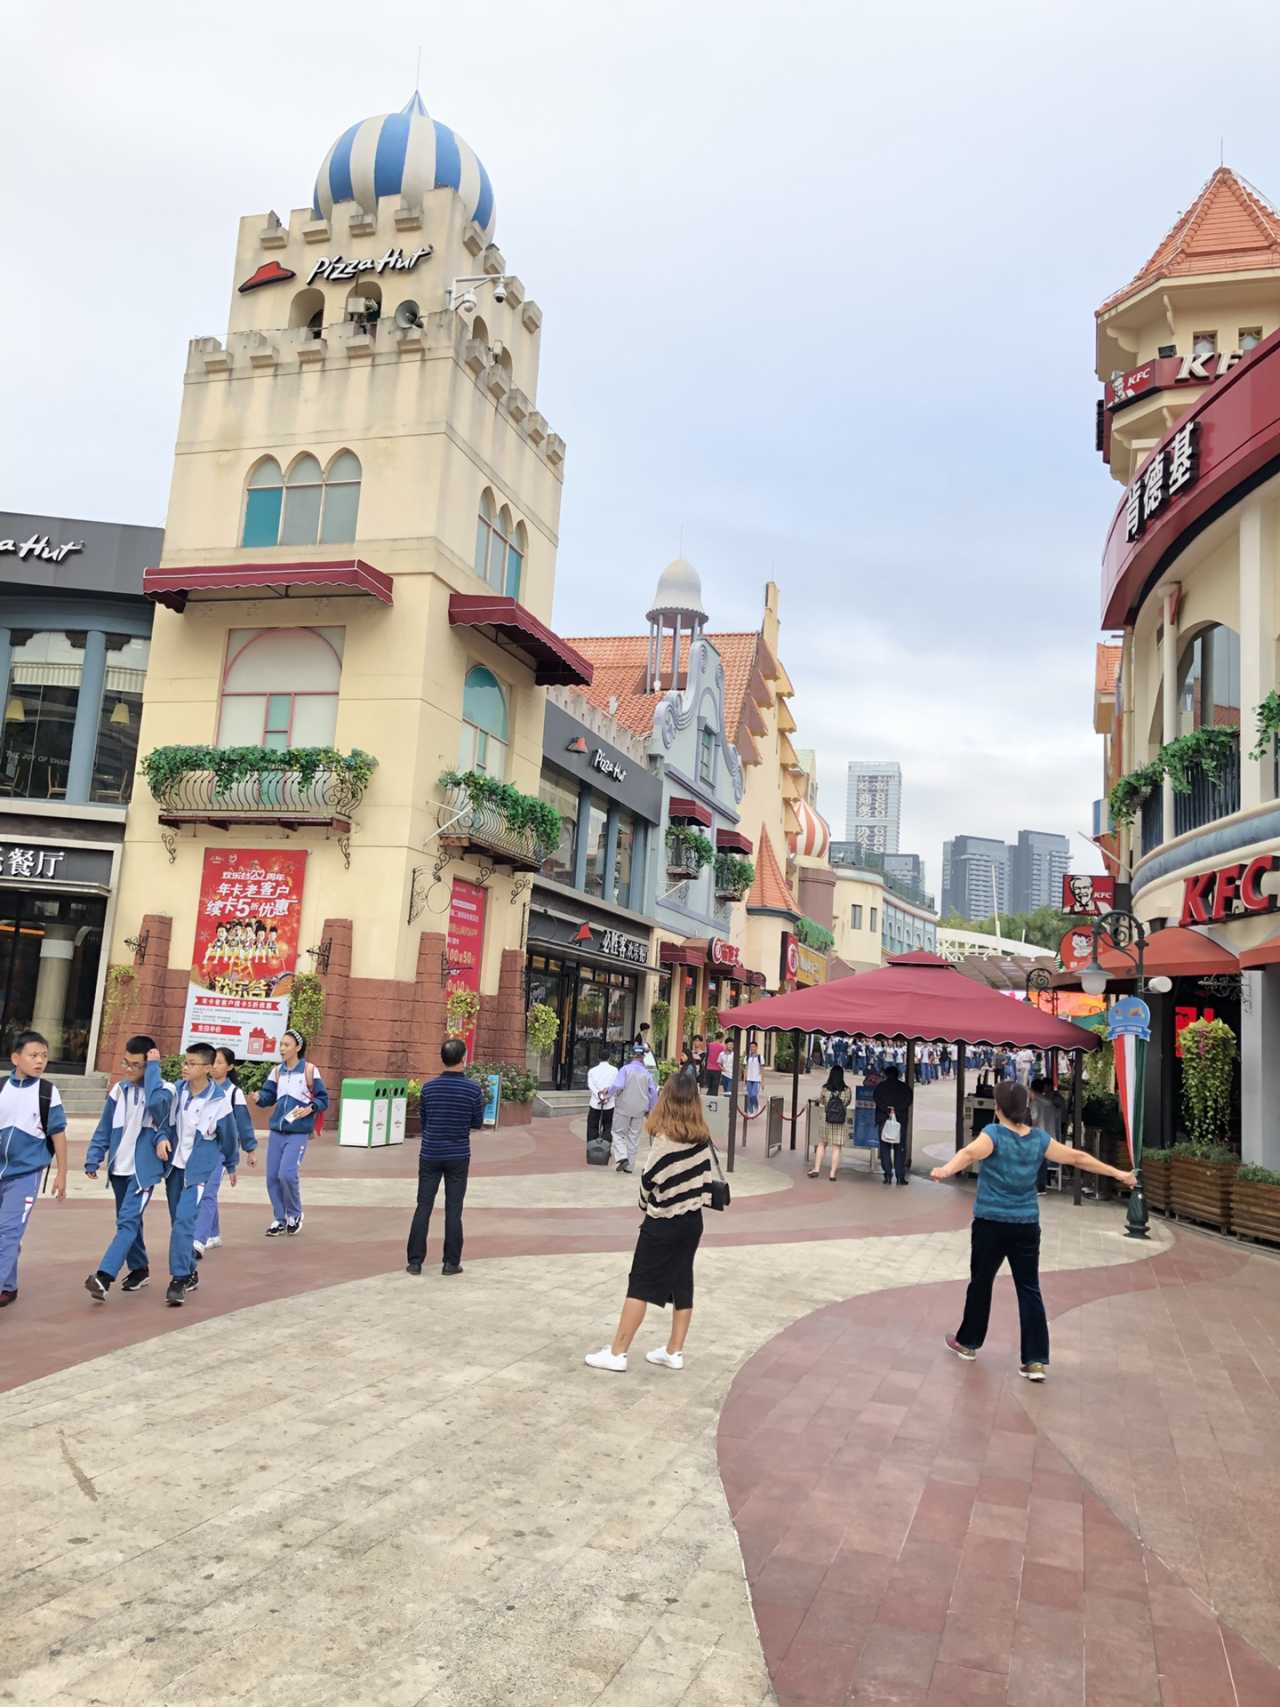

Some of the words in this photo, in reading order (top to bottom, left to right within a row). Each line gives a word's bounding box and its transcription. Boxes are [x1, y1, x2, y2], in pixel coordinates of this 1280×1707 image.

[306, 256, 373, 285] Pizza
[376, 248, 430, 275] Hut
[1127, 367, 1151, 387] KFC
[1175, 350, 1244, 382] KF
[1126, 420, 1196, 540] 肯德基
[19, 534, 81, 561] Hut
[594, 749, 613, 773] Pizza
[613, 761, 627, 782] Hut
[0, 846, 64, 877] 餐厅
[216, 881, 289, 898] 年卡老客户
[1093, 891, 1113, 900] KFC
[1178, 854, 1274, 929] KFC
